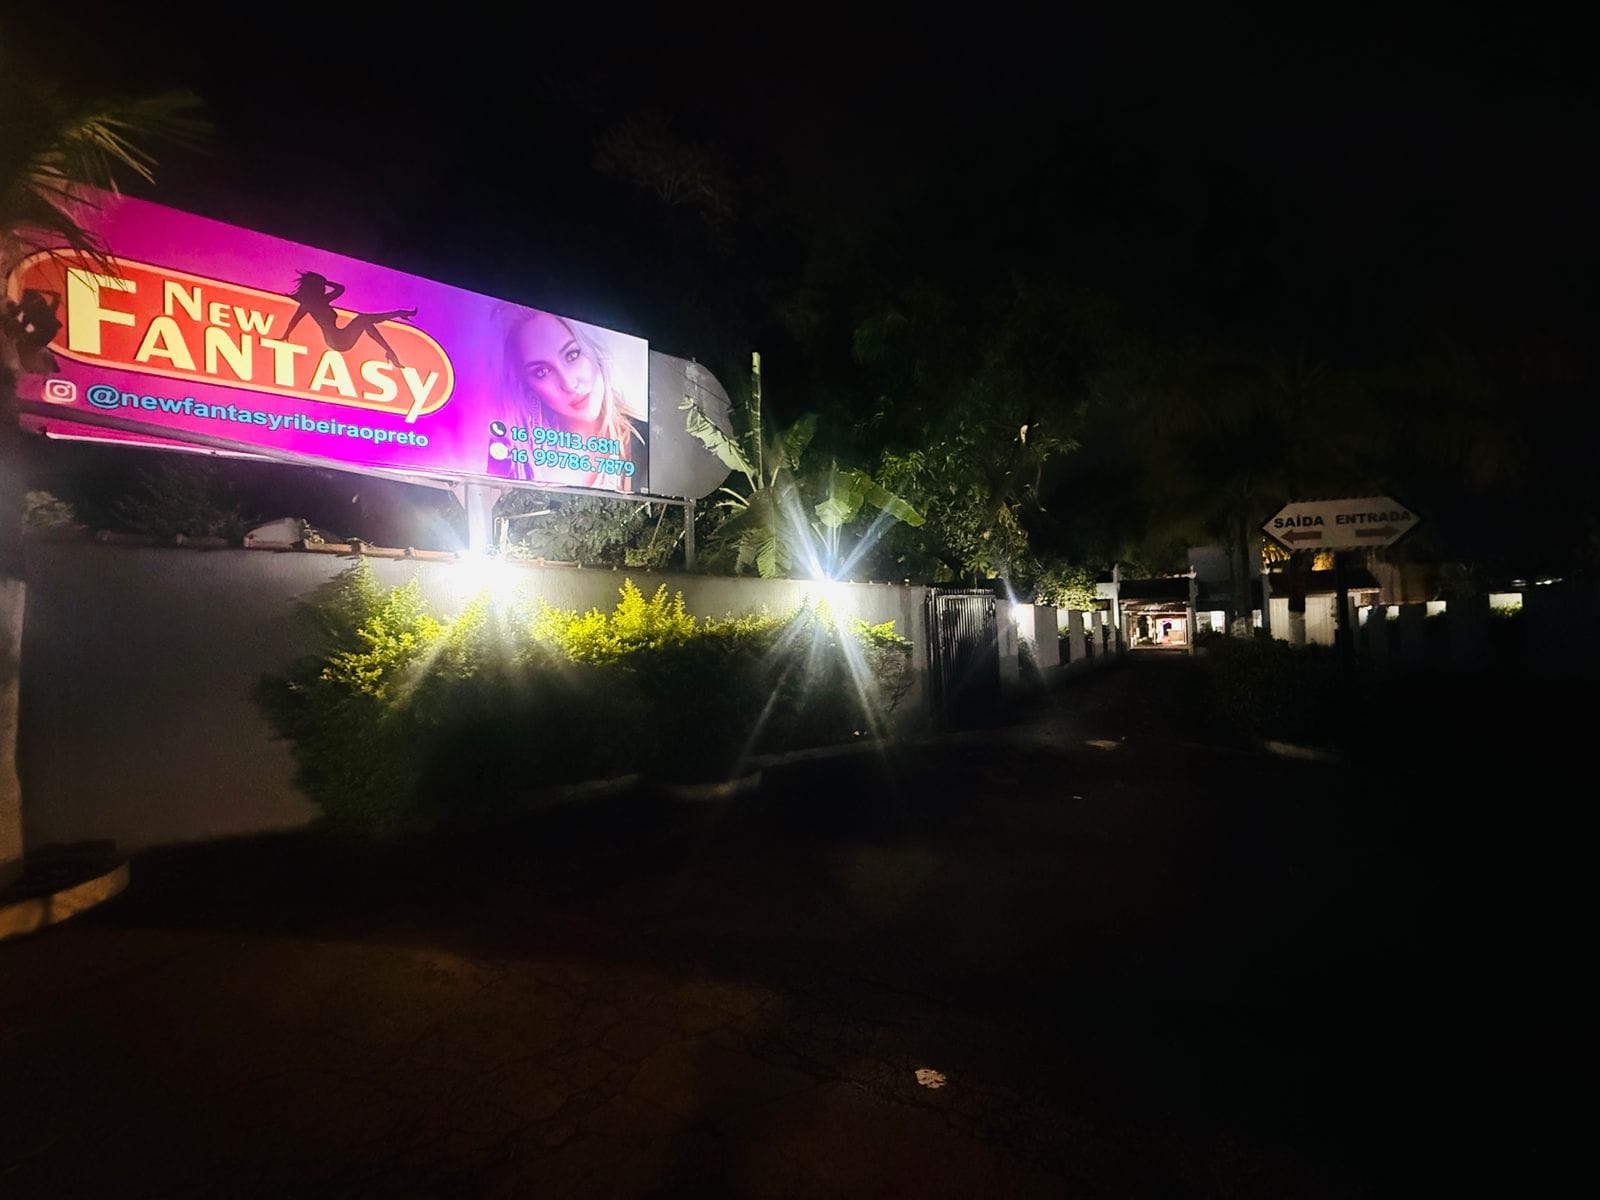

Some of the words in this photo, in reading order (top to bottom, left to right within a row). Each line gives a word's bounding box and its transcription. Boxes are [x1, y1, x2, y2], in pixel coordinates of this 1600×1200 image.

[164, 281, 275, 335] NEW
[86, 384, 430, 448] @newfantasyribeiraopreto
[511, 427, 528, 441] 16
[533, 427, 621, 455] 99113.6811
[511, 448, 528, 463] 16
[533, 448, 635, 476] 99786.7879
[1273, 513, 1325, 528] SAÍDA
[1335, 510, 1411, 525] ENTRADA
